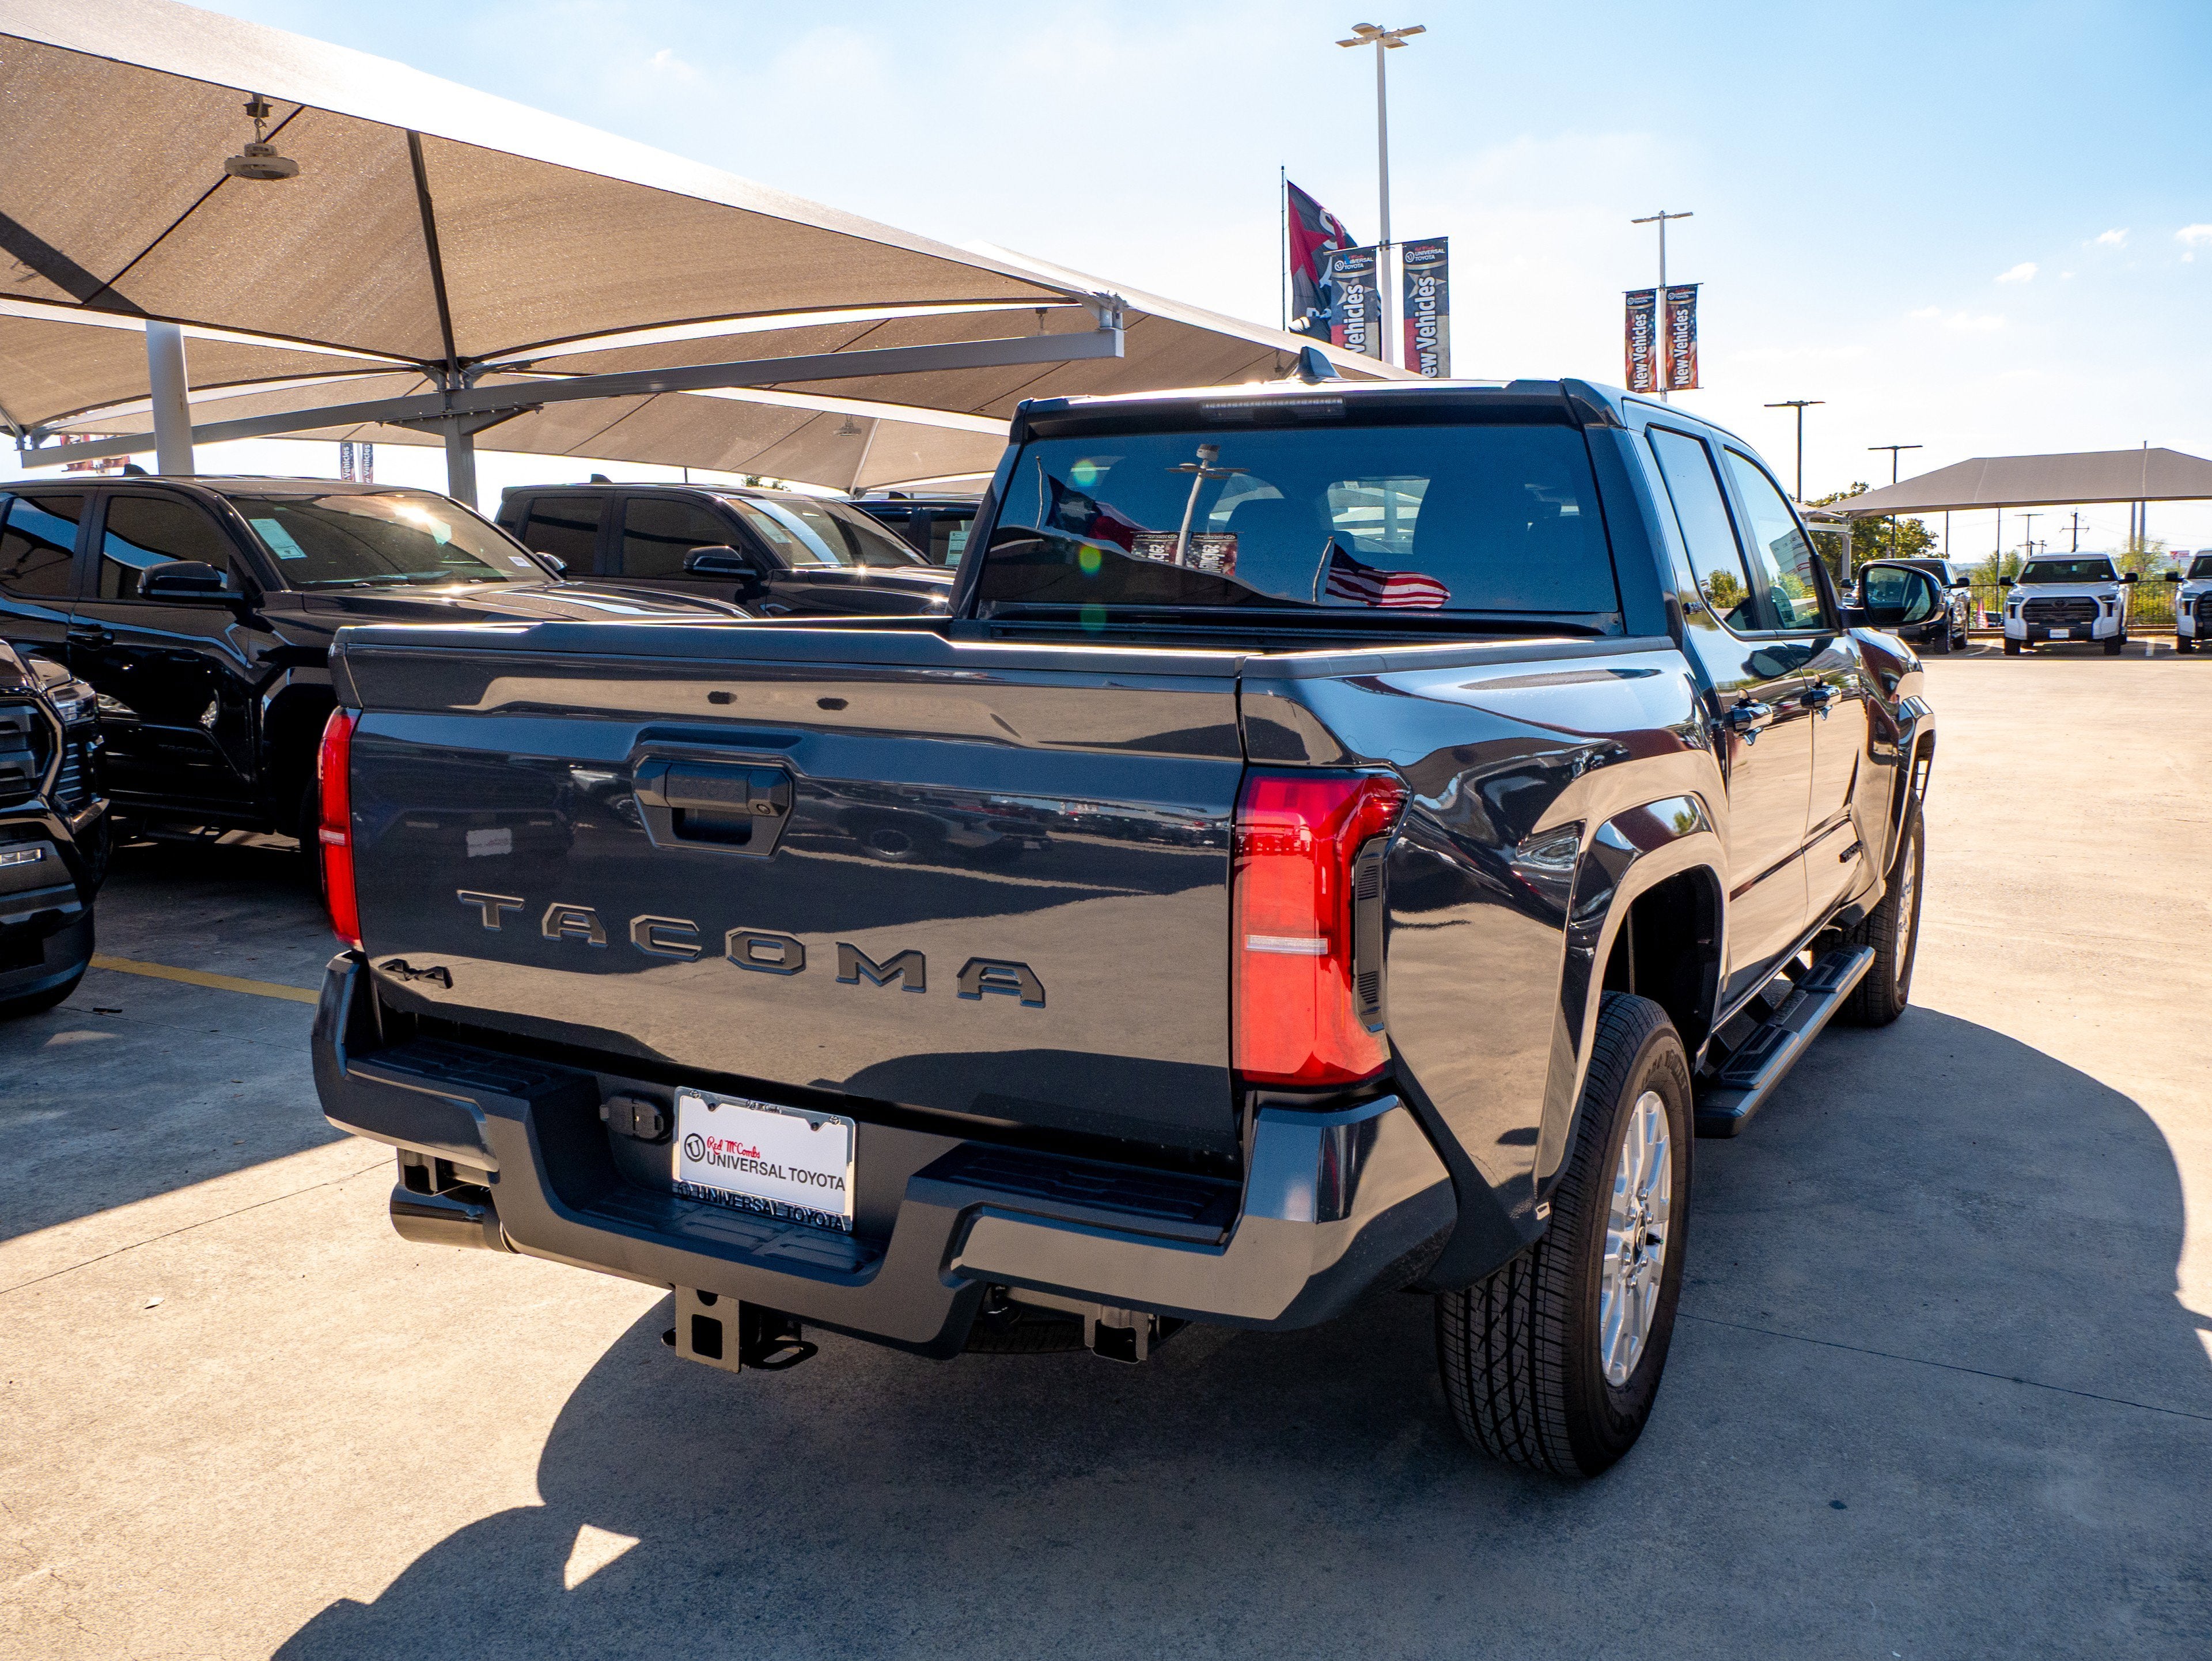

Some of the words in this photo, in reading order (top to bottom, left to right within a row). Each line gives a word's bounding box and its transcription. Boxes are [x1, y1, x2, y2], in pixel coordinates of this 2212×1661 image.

[1343, 284, 1366, 353] Vehicles
[1414, 276, 1437, 350] Vehicles
[1673, 309, 1688, 358] Vehicles
[1632, 313, 1647, 362] Vehicles
[1421, 352, 1438, 378] ew
[1634, 363, 1649, 389] New
[1674, 359, 1690, 385] New
[342, 446, 351, 479] Vehicles
[457, 890, 1046, 1008] TACOMA
[707, 1136, 724, 1155] Red
[725, 1140, 760, 1159] McCombs
[707, 1151, 786, 1179] UNIVERSAL
[788, 1167, 846, 1191] TOYOTA
[698, 1185, 783, 1216] UNIVERSAL
[785, 1204, 847, 1231] TOYOTA
